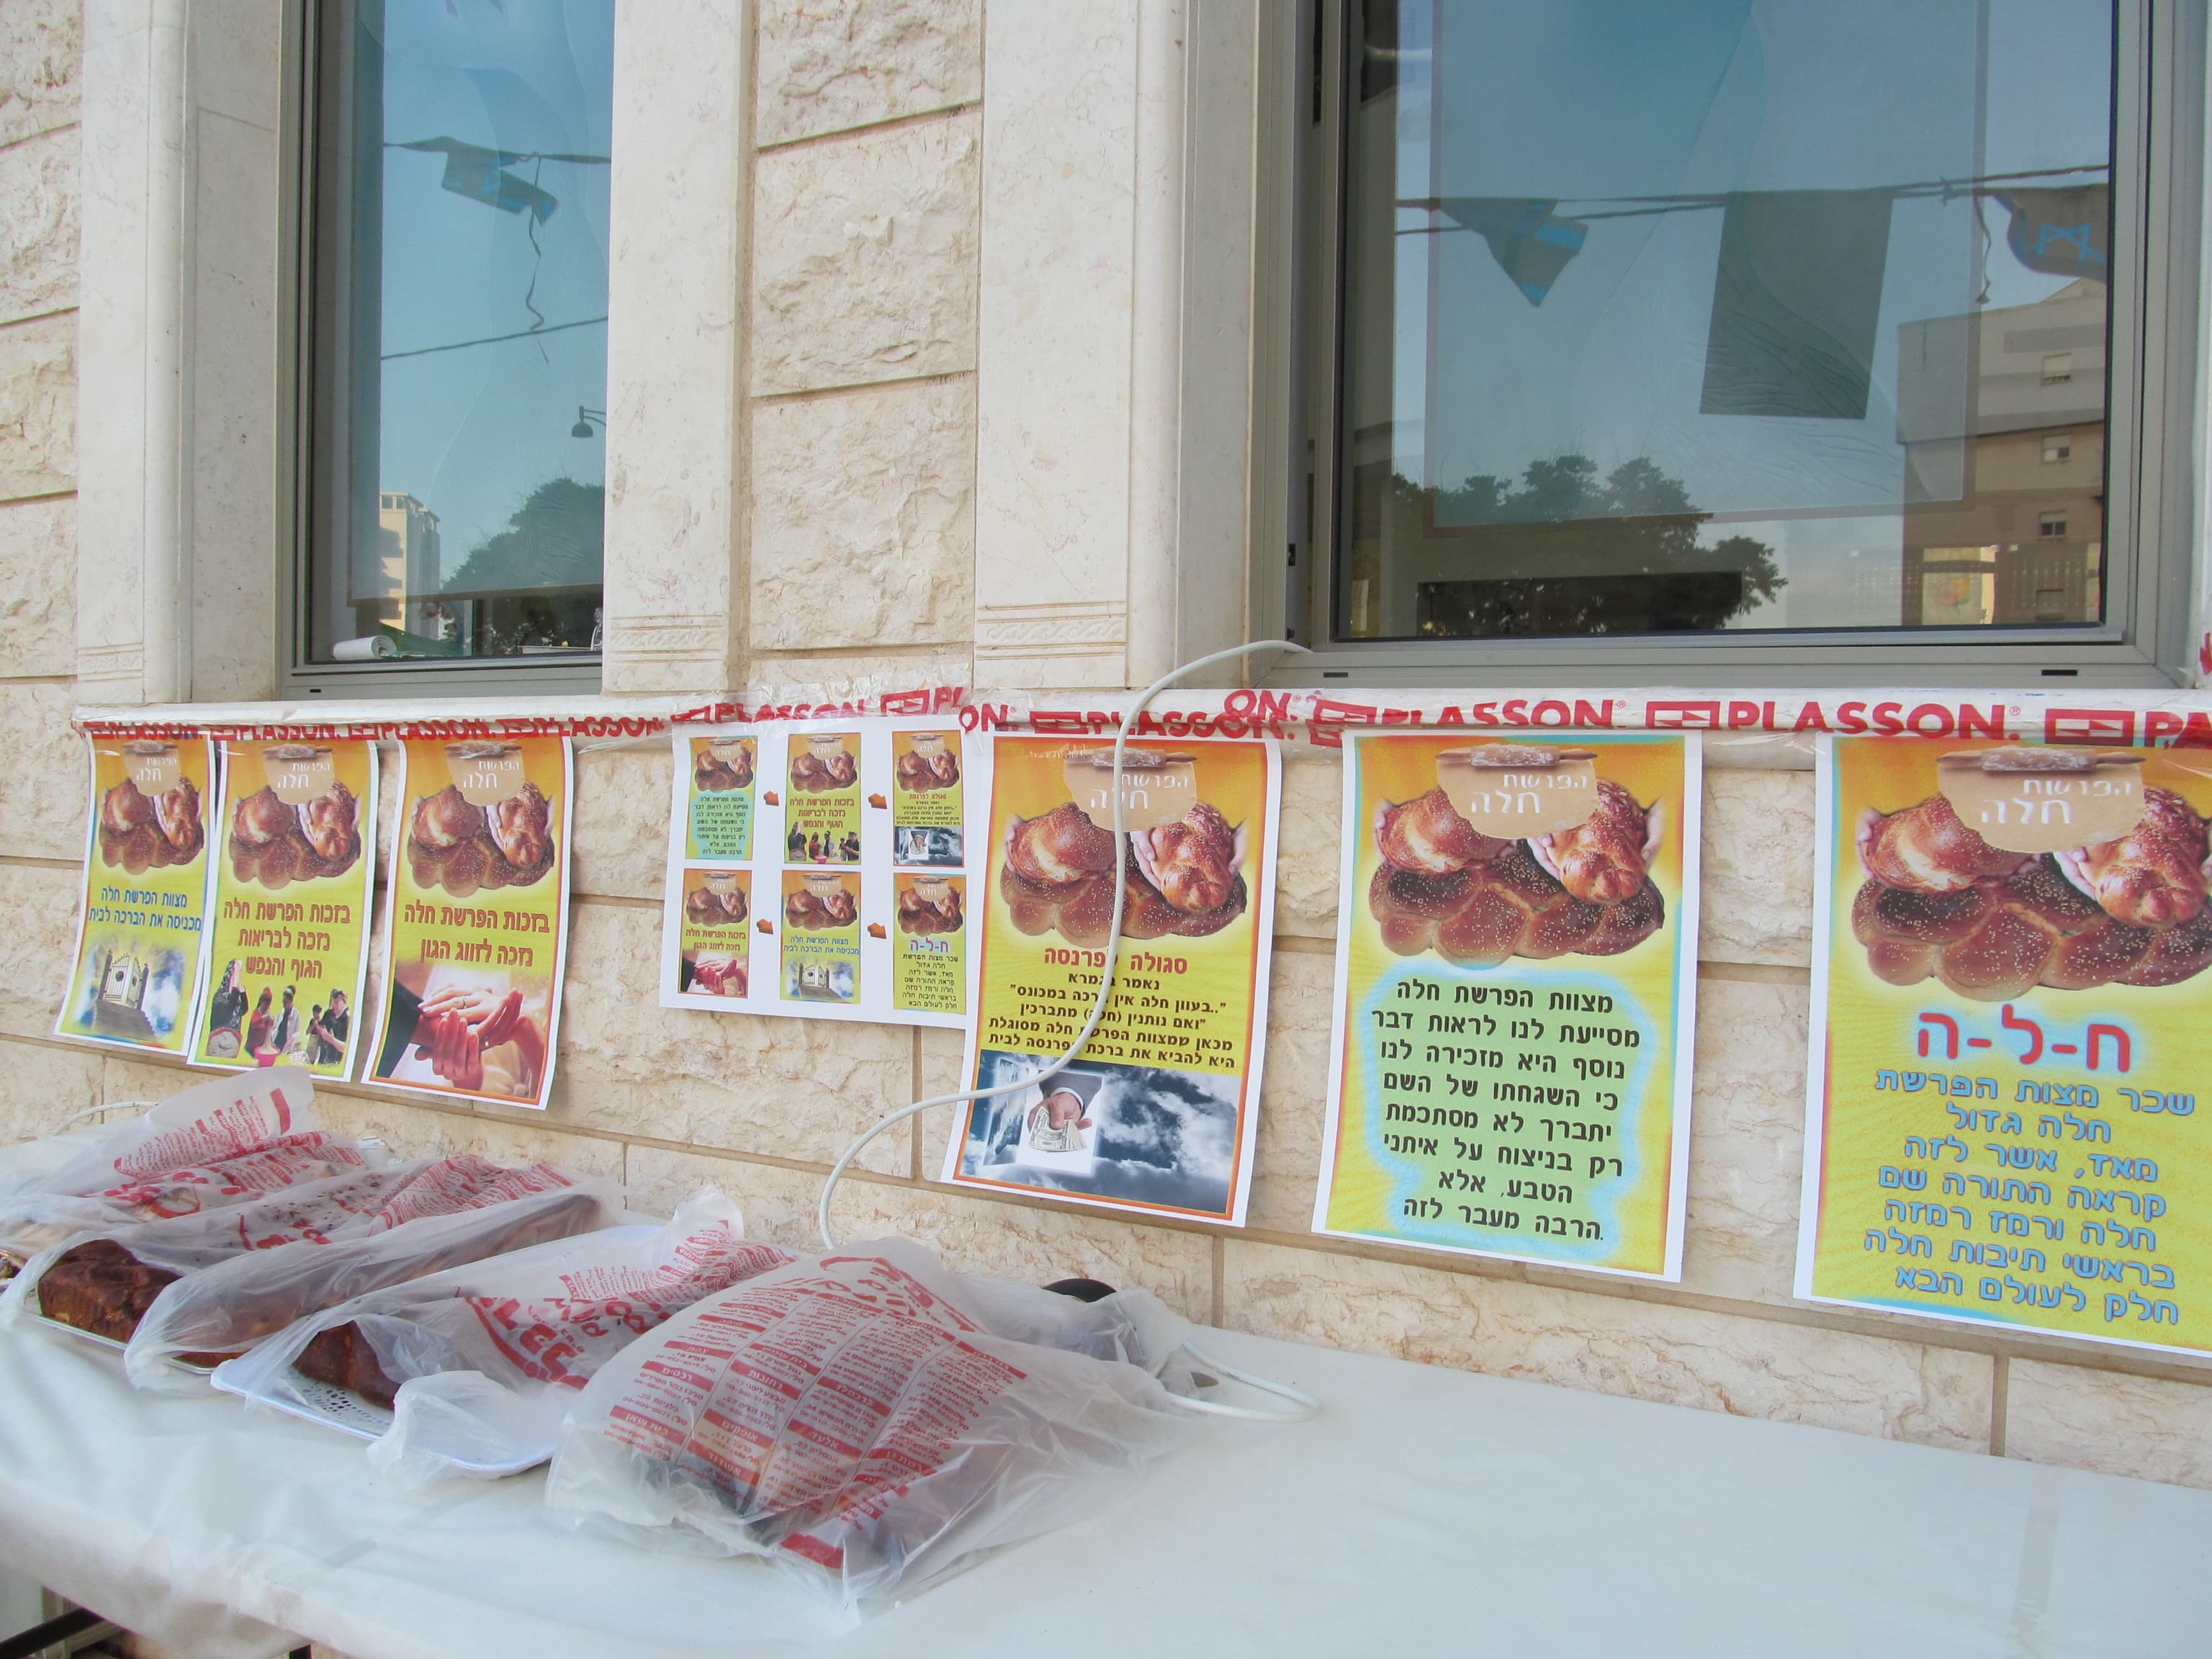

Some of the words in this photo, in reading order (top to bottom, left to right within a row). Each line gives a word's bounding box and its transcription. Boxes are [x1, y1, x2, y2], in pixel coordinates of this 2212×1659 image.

[136, 768, 161, 781] חלה
[277, 773, 309, 788] חלה
[464, 773, 498, 788] חלה
[1091, 787, 1148, 809] חה
[1471, 789, 1540, 814] חלה
[1982, 797, 2071, 824] חלה
[102, 885, 120, 902] חלה
[124, 890, 157, 904] הפרשת
[162, 893, 187, 908] מצוות
[89, 907, 110, 922] לבית
[114, 910, 145, 925] הברכה
[224, 896, 250, 920] חלה
[256, 902, 303, 922] הפרשת
[310, 904, 350, 924] בזכות
[405, 899, 436, 924] חלה
[441, 907, 498, 928] הפרשת
[150, 914, 163, 927] את
[166, 915, 202, 931] מכניסה
[503, 912, 549, 932] בזכות
[238, 926, 292, 948] לבריאות
[297, 931, 331, 951] נזכה
[421, 939, 450, 963] הגון
[455, 938, 492, 963] לזווג
[497, 945, 533, 967] נזכה
[1045, 947, 1118, 967] פרנסה
[246, 956, 285, 976] והנפש
[291, 959, 323, 981] הגוף
[1130, 951, 1187, 974] סגולה
[1123, 978, 1159, 989] נאמר
[1398, 979, 1439, 1001] חלה
[1073, 992, 1107, 1004] רכה
[1115, 995, 1134, 1007] אין
[1141, 997, 1169, 1009] חלה
[1455, 985, 1533, 1008] הפרשת
[1550, 991, 1613, 1014] מצוות
[1020, 1003, 1077, 1017] מתברכין
[1128, 1013, 1166, 1026] נותנין
[1372, 1010, 1413, 1029] דבר
[989, 1017, 1040, 1031] מסוגלת
[1046, 1020, 1072, 1035] חלה
[1429, 1014, 1496, 1036] לראות
[1511, 1018, 1544, 1040] לנו
[989, 1033, 1020, 1045] לבית
[1027, 1037, 1075, 1051] פרנסה
[1136, 1033, 1189, 1046] שמצוות
[1196, 1039, 1232, 1051] מכאן
[1559, 1023, 1640, 1048] מסייעת
[1918, 1004, 2131, 1073] ח-ל-ה
[1087, 1043, 1123, 1056] ברכת
[1130, 1048, 1151, 1059] את
[1158, 1049, 1202, 1065] להביא
[1381, 1039, 1412, 1060] לנו
[1426, 1045, 1503, 1068] מזכירה
[1209, 1056, 1235, 1068] היא
[1518, 1053, 1556, 1072] היא
[1573, 1057, 1624, 1079] נוסף
[1384, 1072, 1430, 1092] השם
[1447, 1074, 1478, 1097] של
[1875, 1069, 1997, 1099] הפרשת
[1493, 1082, 1580, 1107] השגחתו
[1595, 1092, 1618, 1110] כי
[2016, 1080, 2099, 1107] מצות
[2118, 1087, 2195, 1116] שכר
[1386, 1103, 1478, 1129] מסתכמת
[1493, 1112, 1524, 1133] לא
[1946, 1102, 2021, 1133] גדול
[1540, 1118, 1611, 1142] יתברך
[2038, 1112, 2111, 1143] חלה
[1384, 1133, 1438, 1155] איתני
[1454, 1138, 1483, 1161] על
[1905, 1135, 1967, 1162] לזה
[1497, 1146, 1572, 1172] בניצוח
[1589, 1156, 1622, 1178] רק
[1986, 1143, 2057, 1171] אשר
[1439, 1170, 1486, 1193] אלא
[1879, 1165, 1927, 1190] שם
[1943, 1172, 2051, 1204] התורה
[1403, 1197, 1442, 1218] לזה
[1884, 1198, 1971, 1228] רמזה
[2069, 1185, 2167, 1220] קראה
[1459, 1205, 1519, 1229] מעבר
[1990, 1210, 2064, 1239] ורמז
[1864, 1227, 1932, 1257] חלה
[2082, 1219, 2156, 1251] חלה
[1949, 1239, 2045, 1272] תיבות
[1895, 1267, 1962, 1295] הבא
[2063, 1254, 2175, 1289] בראשי
[1979, 1274, 2086, 1311] לעולם
[2104, 1291, 2178, 1325] חלק
